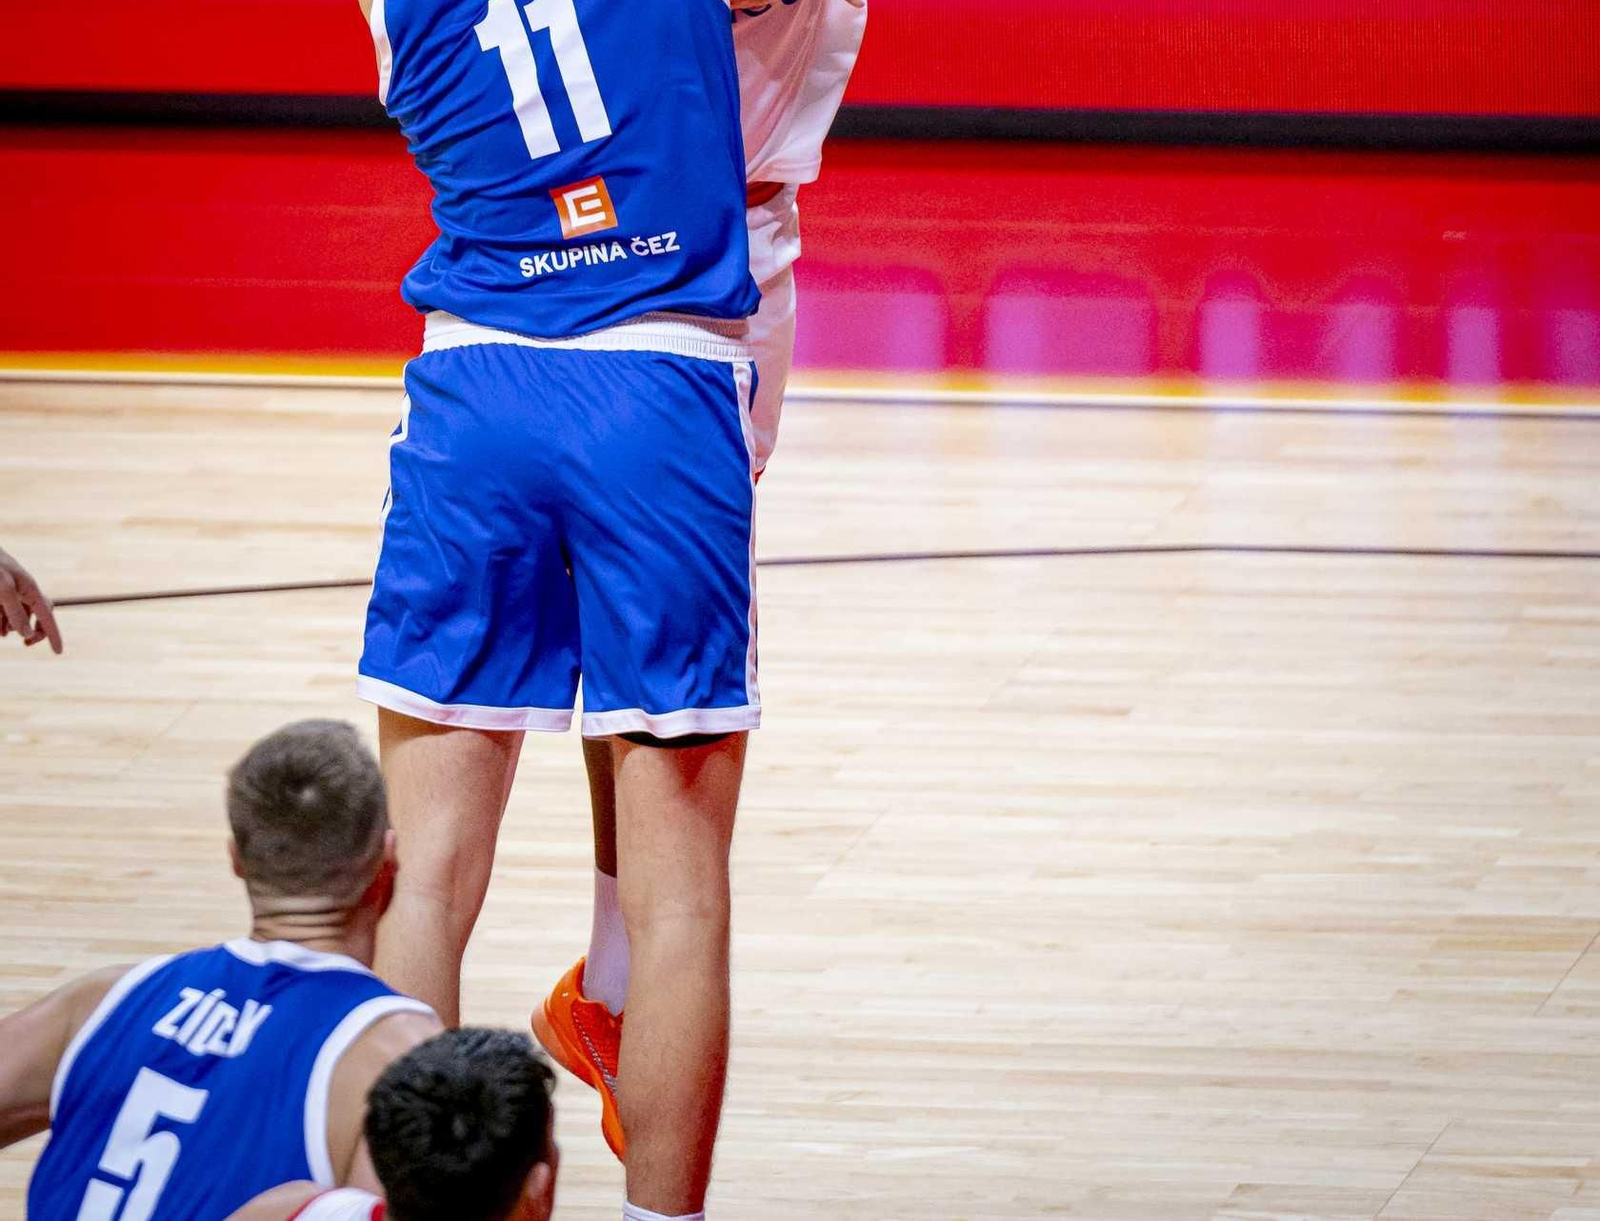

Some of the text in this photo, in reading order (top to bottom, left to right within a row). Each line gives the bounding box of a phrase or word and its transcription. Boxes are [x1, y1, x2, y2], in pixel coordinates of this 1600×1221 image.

[519, 231, 681, 278] SKUPINA ČEZ
[75, 1065, 210, 1221] 5
